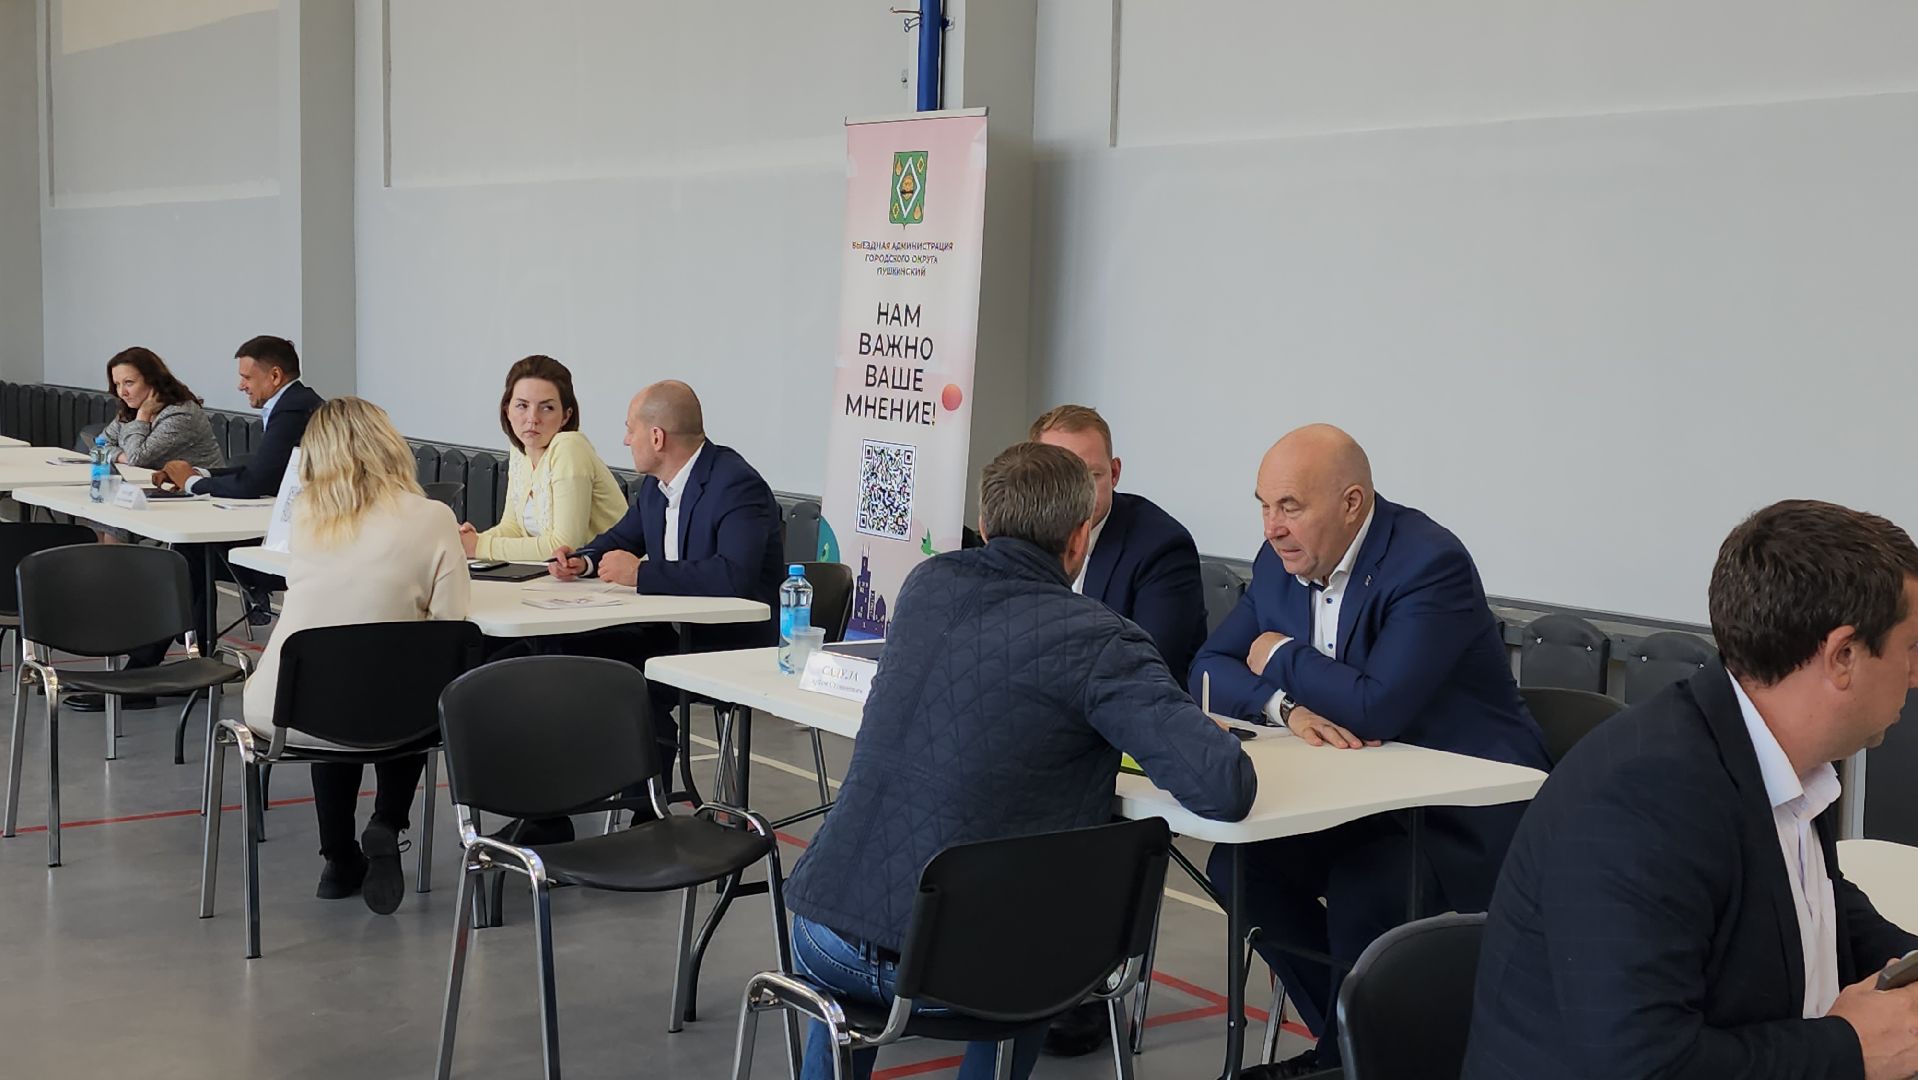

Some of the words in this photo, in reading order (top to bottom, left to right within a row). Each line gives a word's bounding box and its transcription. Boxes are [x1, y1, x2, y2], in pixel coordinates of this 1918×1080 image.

[864, 254, 910, 263] ГОРОДСКОГО
[911, 254, 938, 264] ОКРУГА
[891, 241, 954, 252] АДМИНИСТРАЦИЯ
[876, 265, 926, 276] ПУШКИНСКИЙ
[876, 301, 922, 328] НАМ
[858, 332, 934, 361] ВАЖНО
[865, 364, 924, 392] ВАШЕ
[845, 393, 936, 426] МНЕНИЕ!
